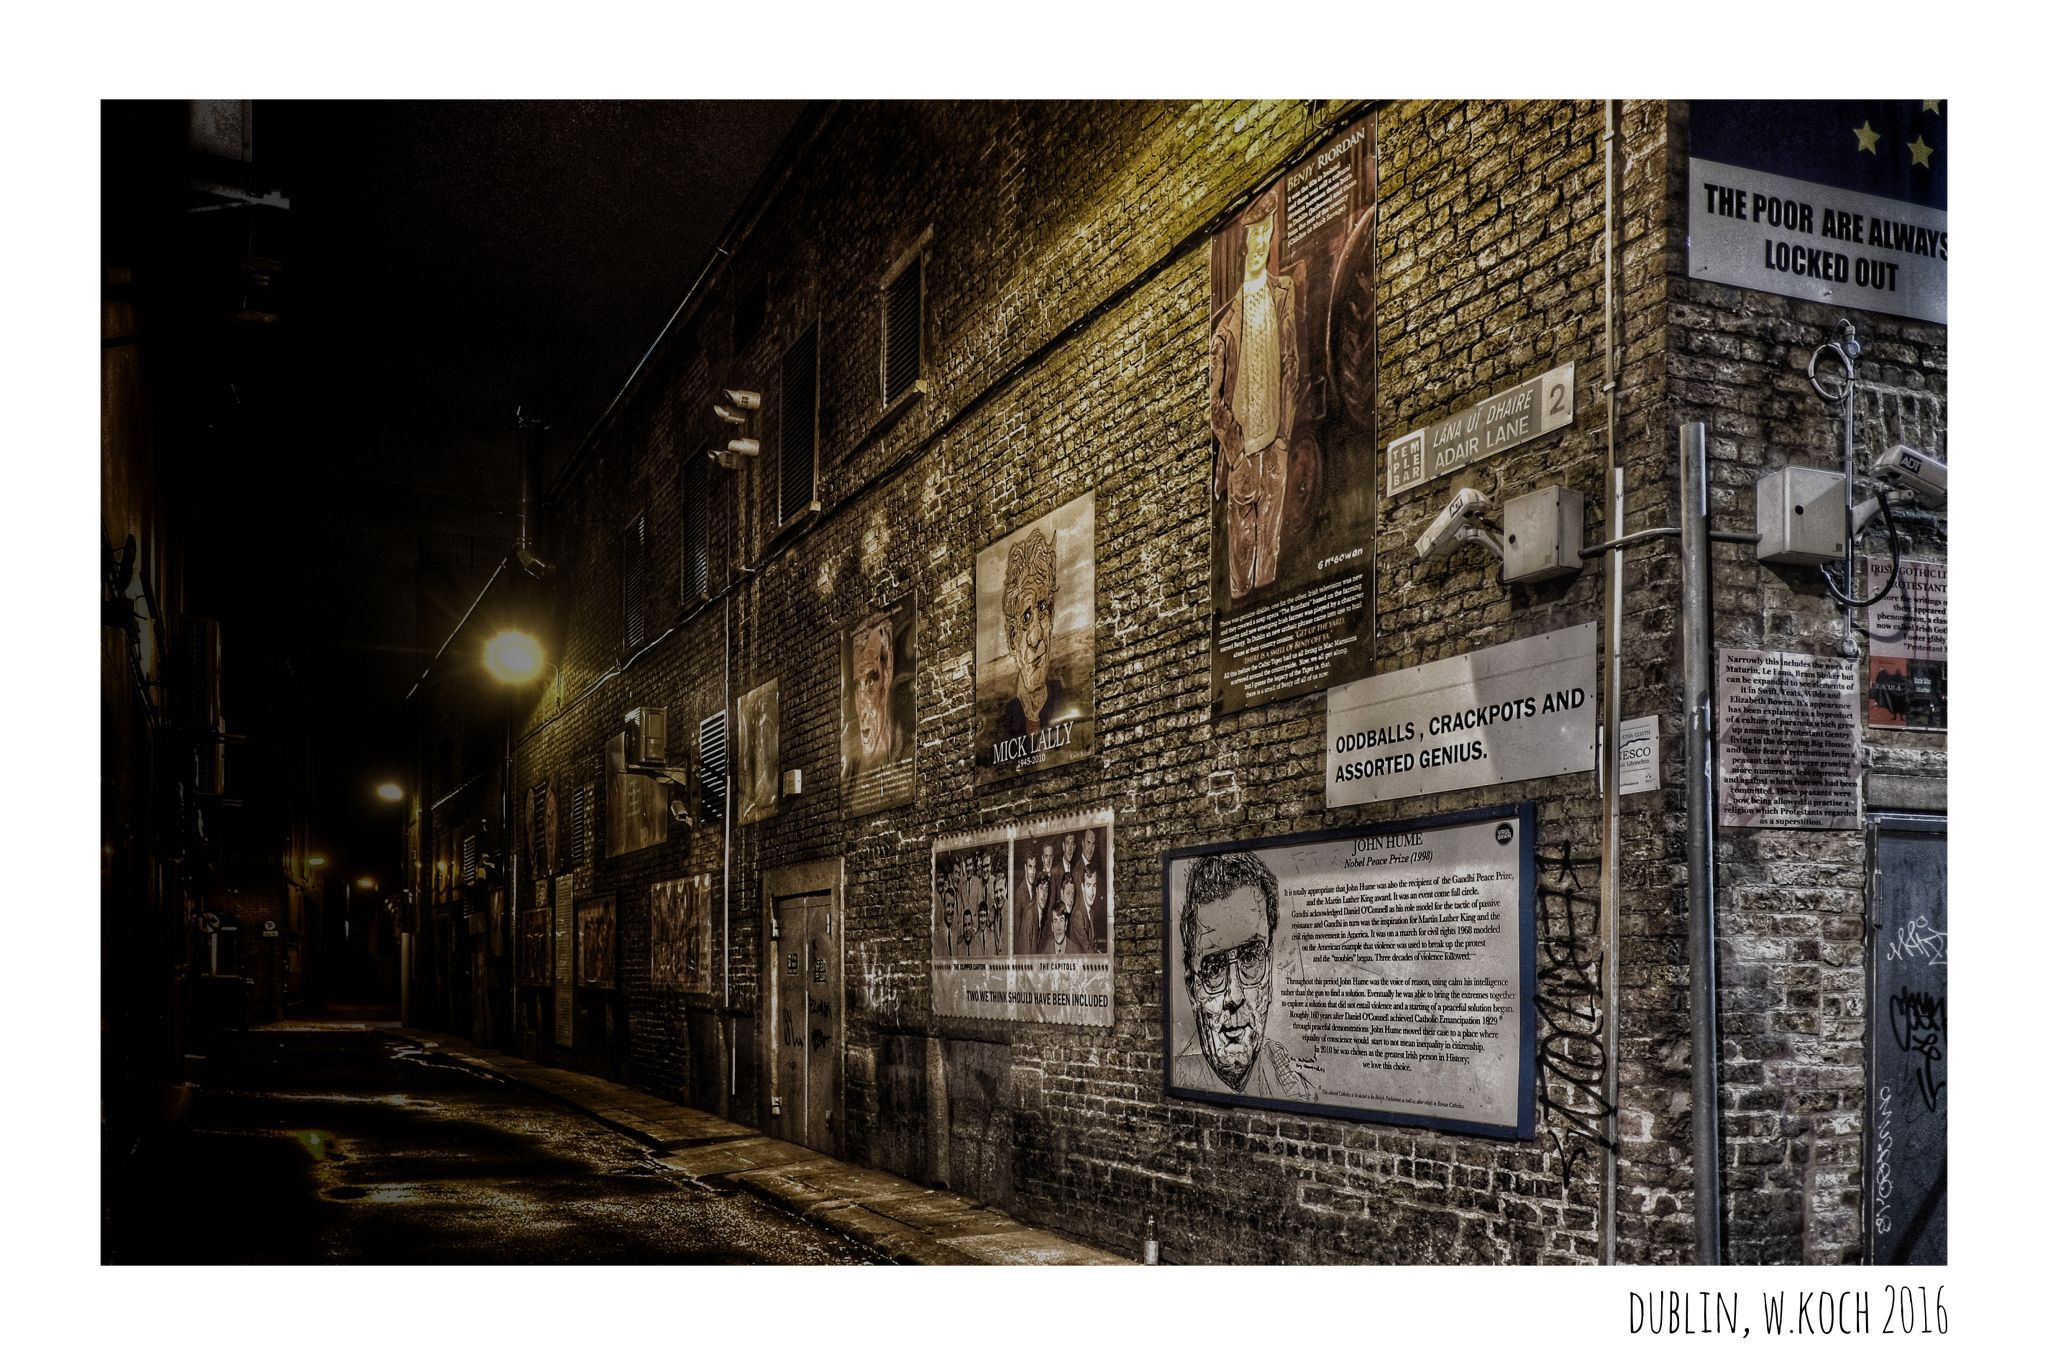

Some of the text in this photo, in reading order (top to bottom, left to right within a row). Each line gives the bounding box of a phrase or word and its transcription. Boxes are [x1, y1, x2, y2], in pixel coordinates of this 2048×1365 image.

[1287, 128, 1364, 192] BENJY RIORDAN
[1704, 183, 1947, 261] THE POOR ARE ALWAYS
[1765, 239, 1898, 292] LOCKED OUT
[1486, 389, 1533, 424] DHAIRE
[1435, 383, 1565, 470] ADAIR LANE 2
[1900, 456, 1920, 471] ADT
[1394, 467, 1420, 486] BAR
[1900, 567, 1935, 578] GOTHIC
[1727, 656, 1763, 667] Narrowly
[1336, 722, 1415, 754] ODDBALLS
[1429, 697, 1536, 736] CRACKPOTS
[1542, 688, 1585, 715] AND
[993, 721, 1074, 764] MICK LALLY
[1335, 740, 1488, 783] ASSORTED GENIUS.
[1724, 808, 1753, 816] religion
[1824, 809, 1856, 818] regarded
[1775, 818, 1822, 827] superstition.
[1352, 833, 1422, 856] JOHN HUME
[1344, 852, 1432, 867] Nobel Peace Prize (1998)
[1476, 871, 1514, 882] Peace Prize,
[1306, 897, 1315, 905] and
[1325, 895, 1341, 904] Martin
[1342, 894, 1359, 903] Luther
[1360, 893, 1373, 904] King
[1393, 892, 1397, 900] It
[1418, 890, 1432, 898] event
[1451, 888, 1460, 896] full
[1313, 953, 1321, 961] and
[1322, 953, 1330, 961] the
[1375, 953, 1390, 961] Three
[1392, 953, 1412, 961] decades
[1051, 963, 1076, 971] CAPITOLS
[1323, 977, 1338, 987] period
[1338, 977, 1351, 985] John
[1353, 977, 1368, 985] Hume
[1432, 979, 1446, 987] using
[1474, 978, 1508, 988] intelligence
[967, 990, 1108, 1007] TWO WE THINK SHOULD HAVE BEEN INCLUDED
[1320, 1046, 1331, 1054] 2010
[1333, 1047, 1338, 1055] he
[1350, 1048, 1366, 1057] chosen
[1384, 1050, 1404, 1061] greatest
[1405, 1052, 1417, 1060] Irish
[1371, 1061, 1381, 1069] love
[1383, 1062, 1391, 1070] this
[1393, 1063, 1411, 1072] choice.
